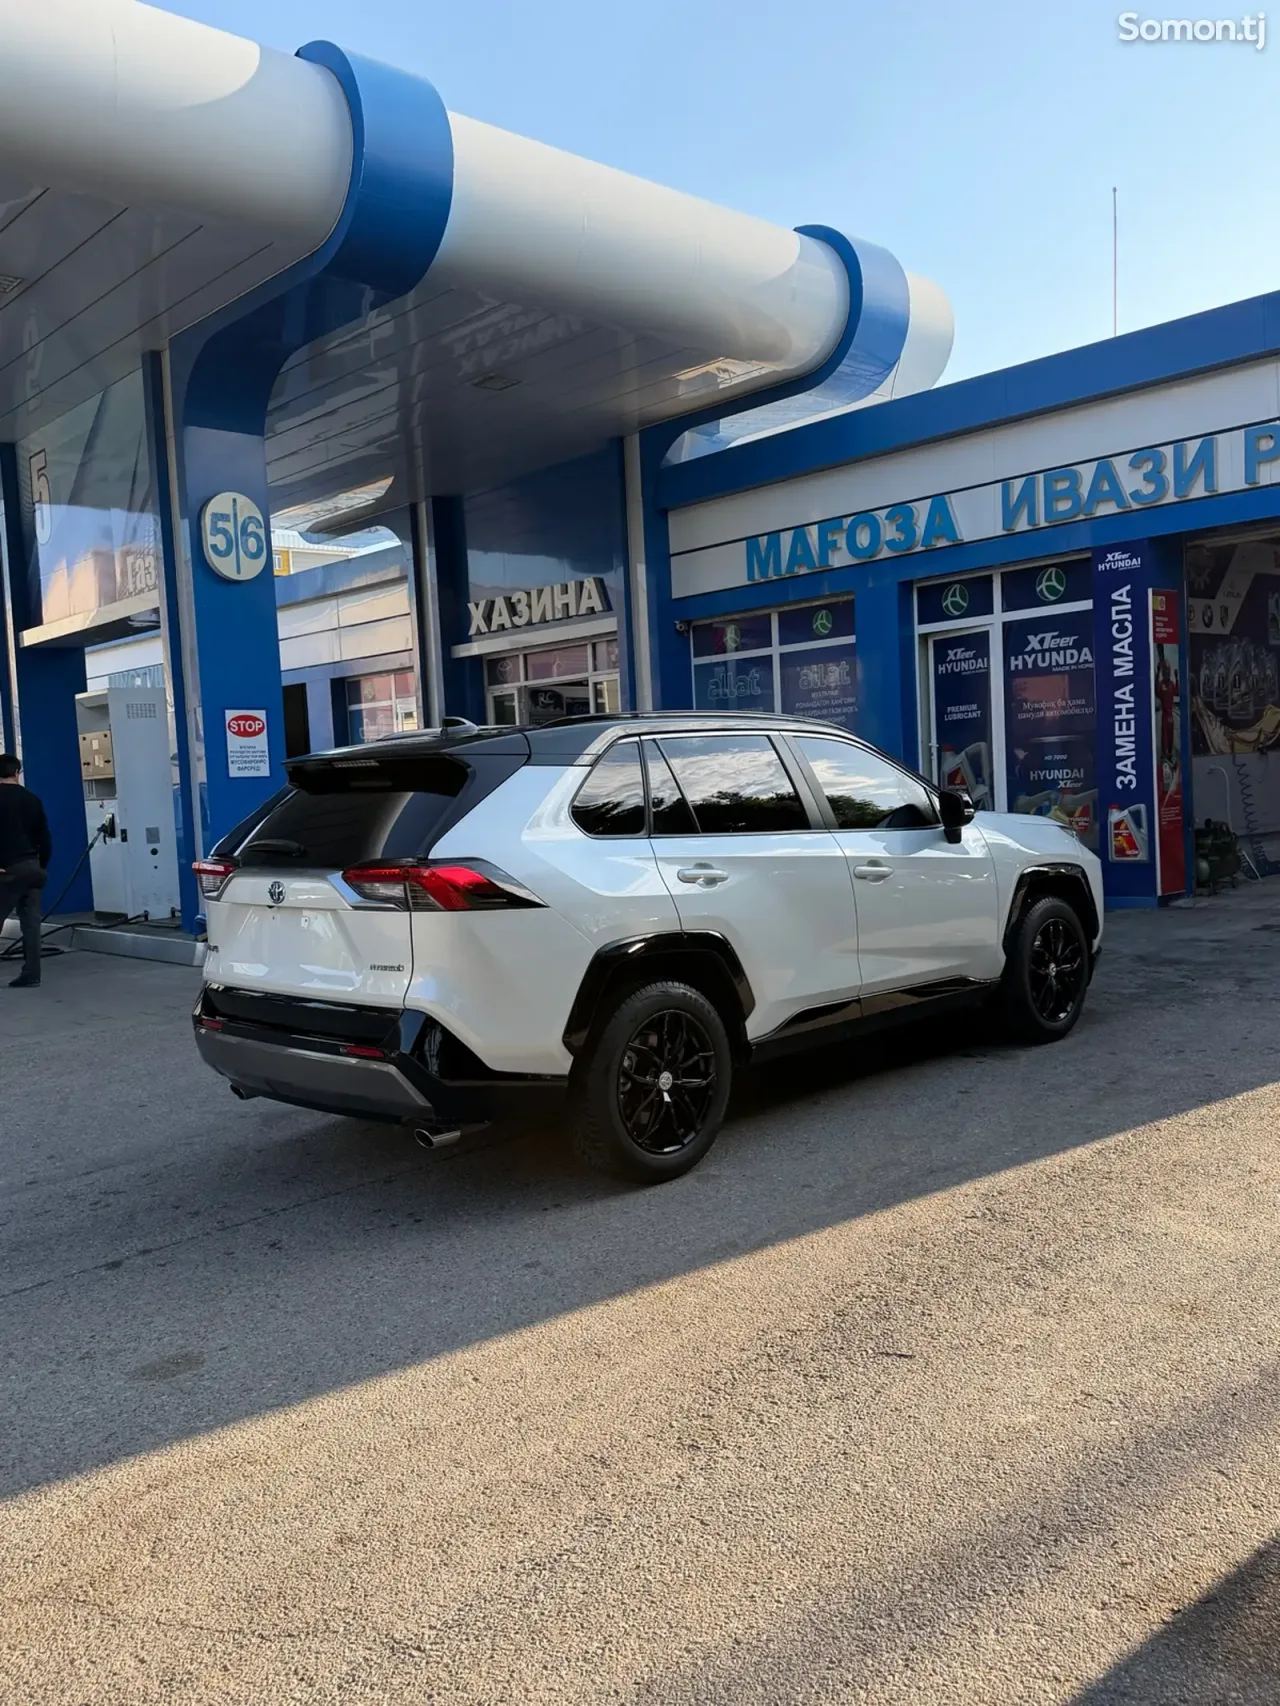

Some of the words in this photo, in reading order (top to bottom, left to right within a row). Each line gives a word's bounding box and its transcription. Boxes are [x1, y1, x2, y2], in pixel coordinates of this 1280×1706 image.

[1001, 437, 1218, 531] ИВАЗИ
[29, 448, 51, 544] 5
[1098, 557, 1141, 571] HYUNDAI
[468, 577, 607, 636] ХАЗИНА
[1110, 584, 1134, 677] МАСЛА
[1024, 631, 1079, 651] XTeer
[945, 648, 976, 662] XTeer
[938, 657, 988, 675] HYUNDAI
[944, 710, 982, 721] LUBRICANT
[947, 704, 978, 713] PREMIUM
[230, 720, 263, 732] STOP
[1114, 683, 1137, 790] ЗАМЕНА
[1030, 768, 1084, 781] HYUNDAI
